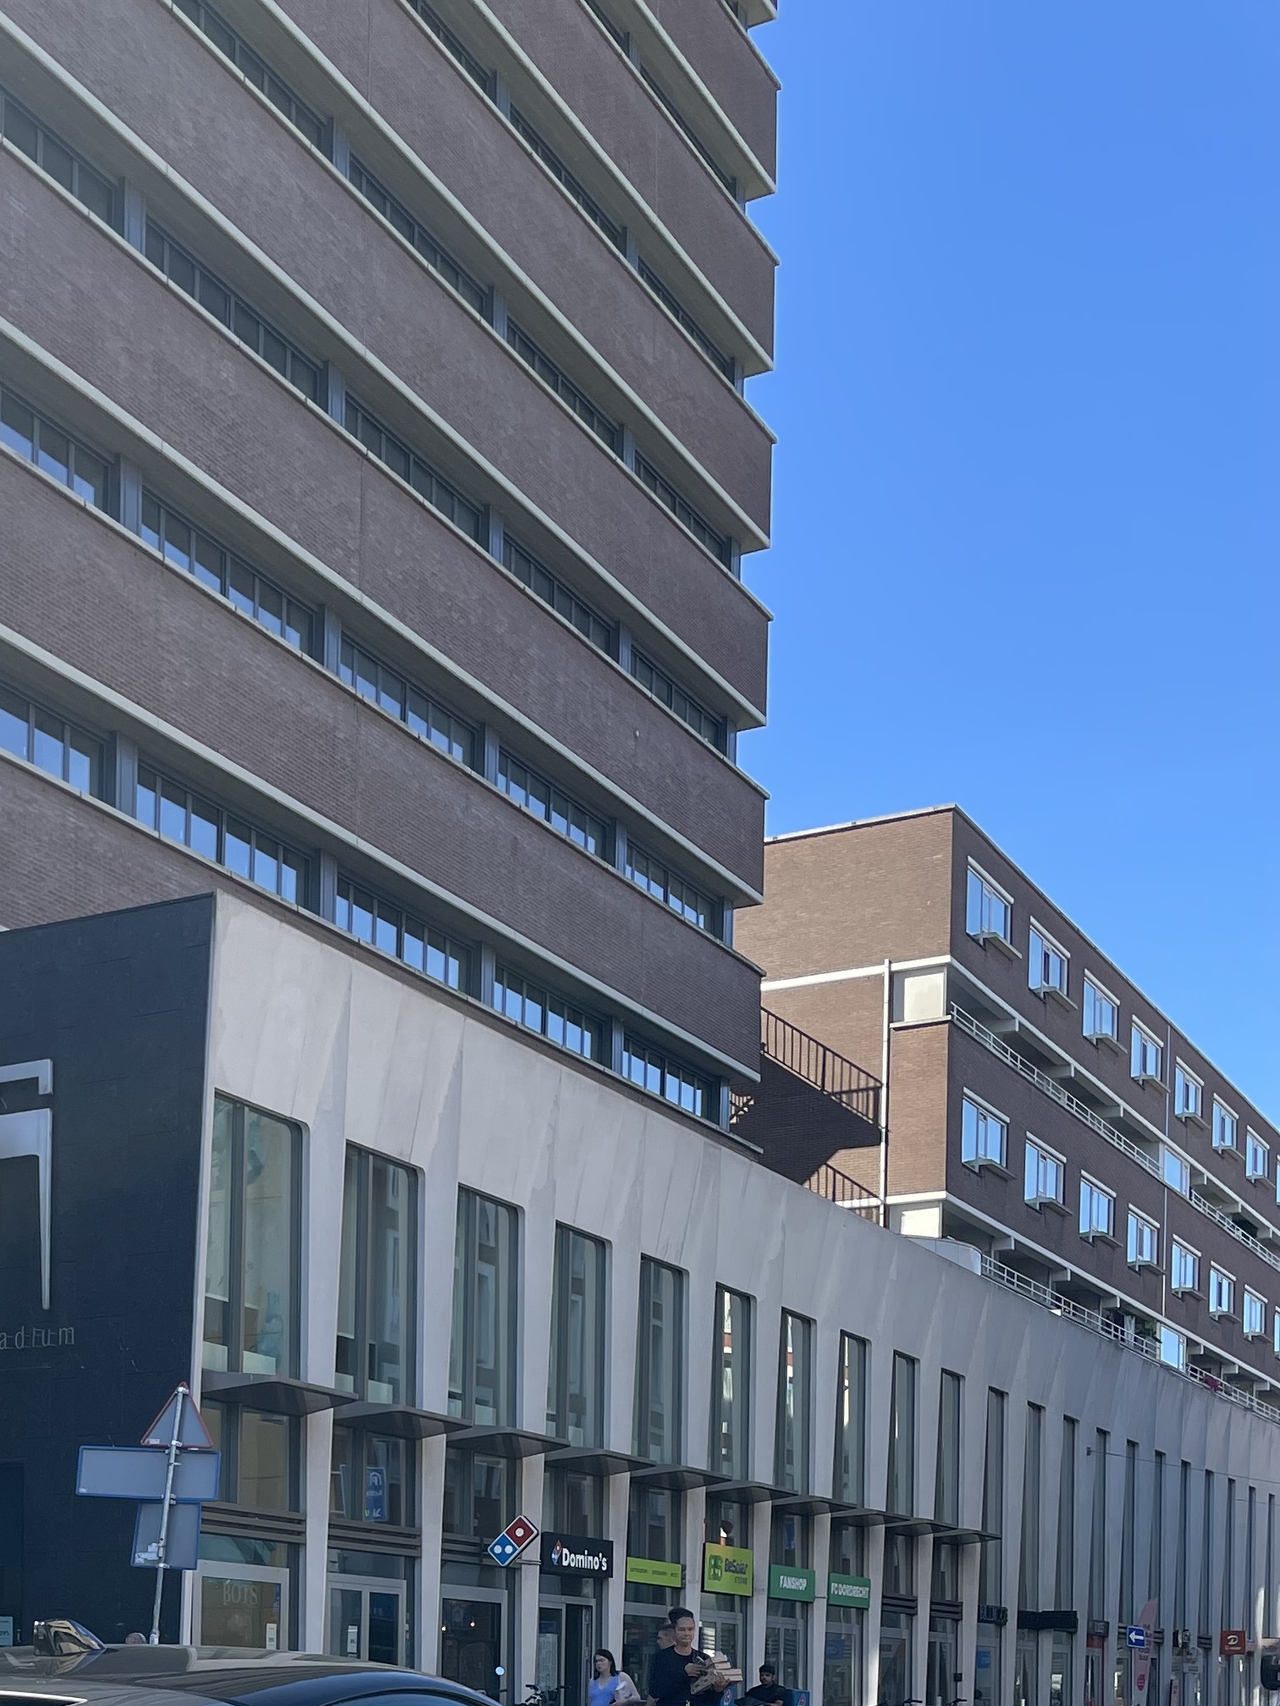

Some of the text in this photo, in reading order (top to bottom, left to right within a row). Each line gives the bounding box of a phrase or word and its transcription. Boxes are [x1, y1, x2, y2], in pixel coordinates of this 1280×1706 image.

[562, 1548, 608, 1571] Domino's
[222, 1582, 258, 1606] BOTS
[780, 1575, 807, 1591] FANSHOP
